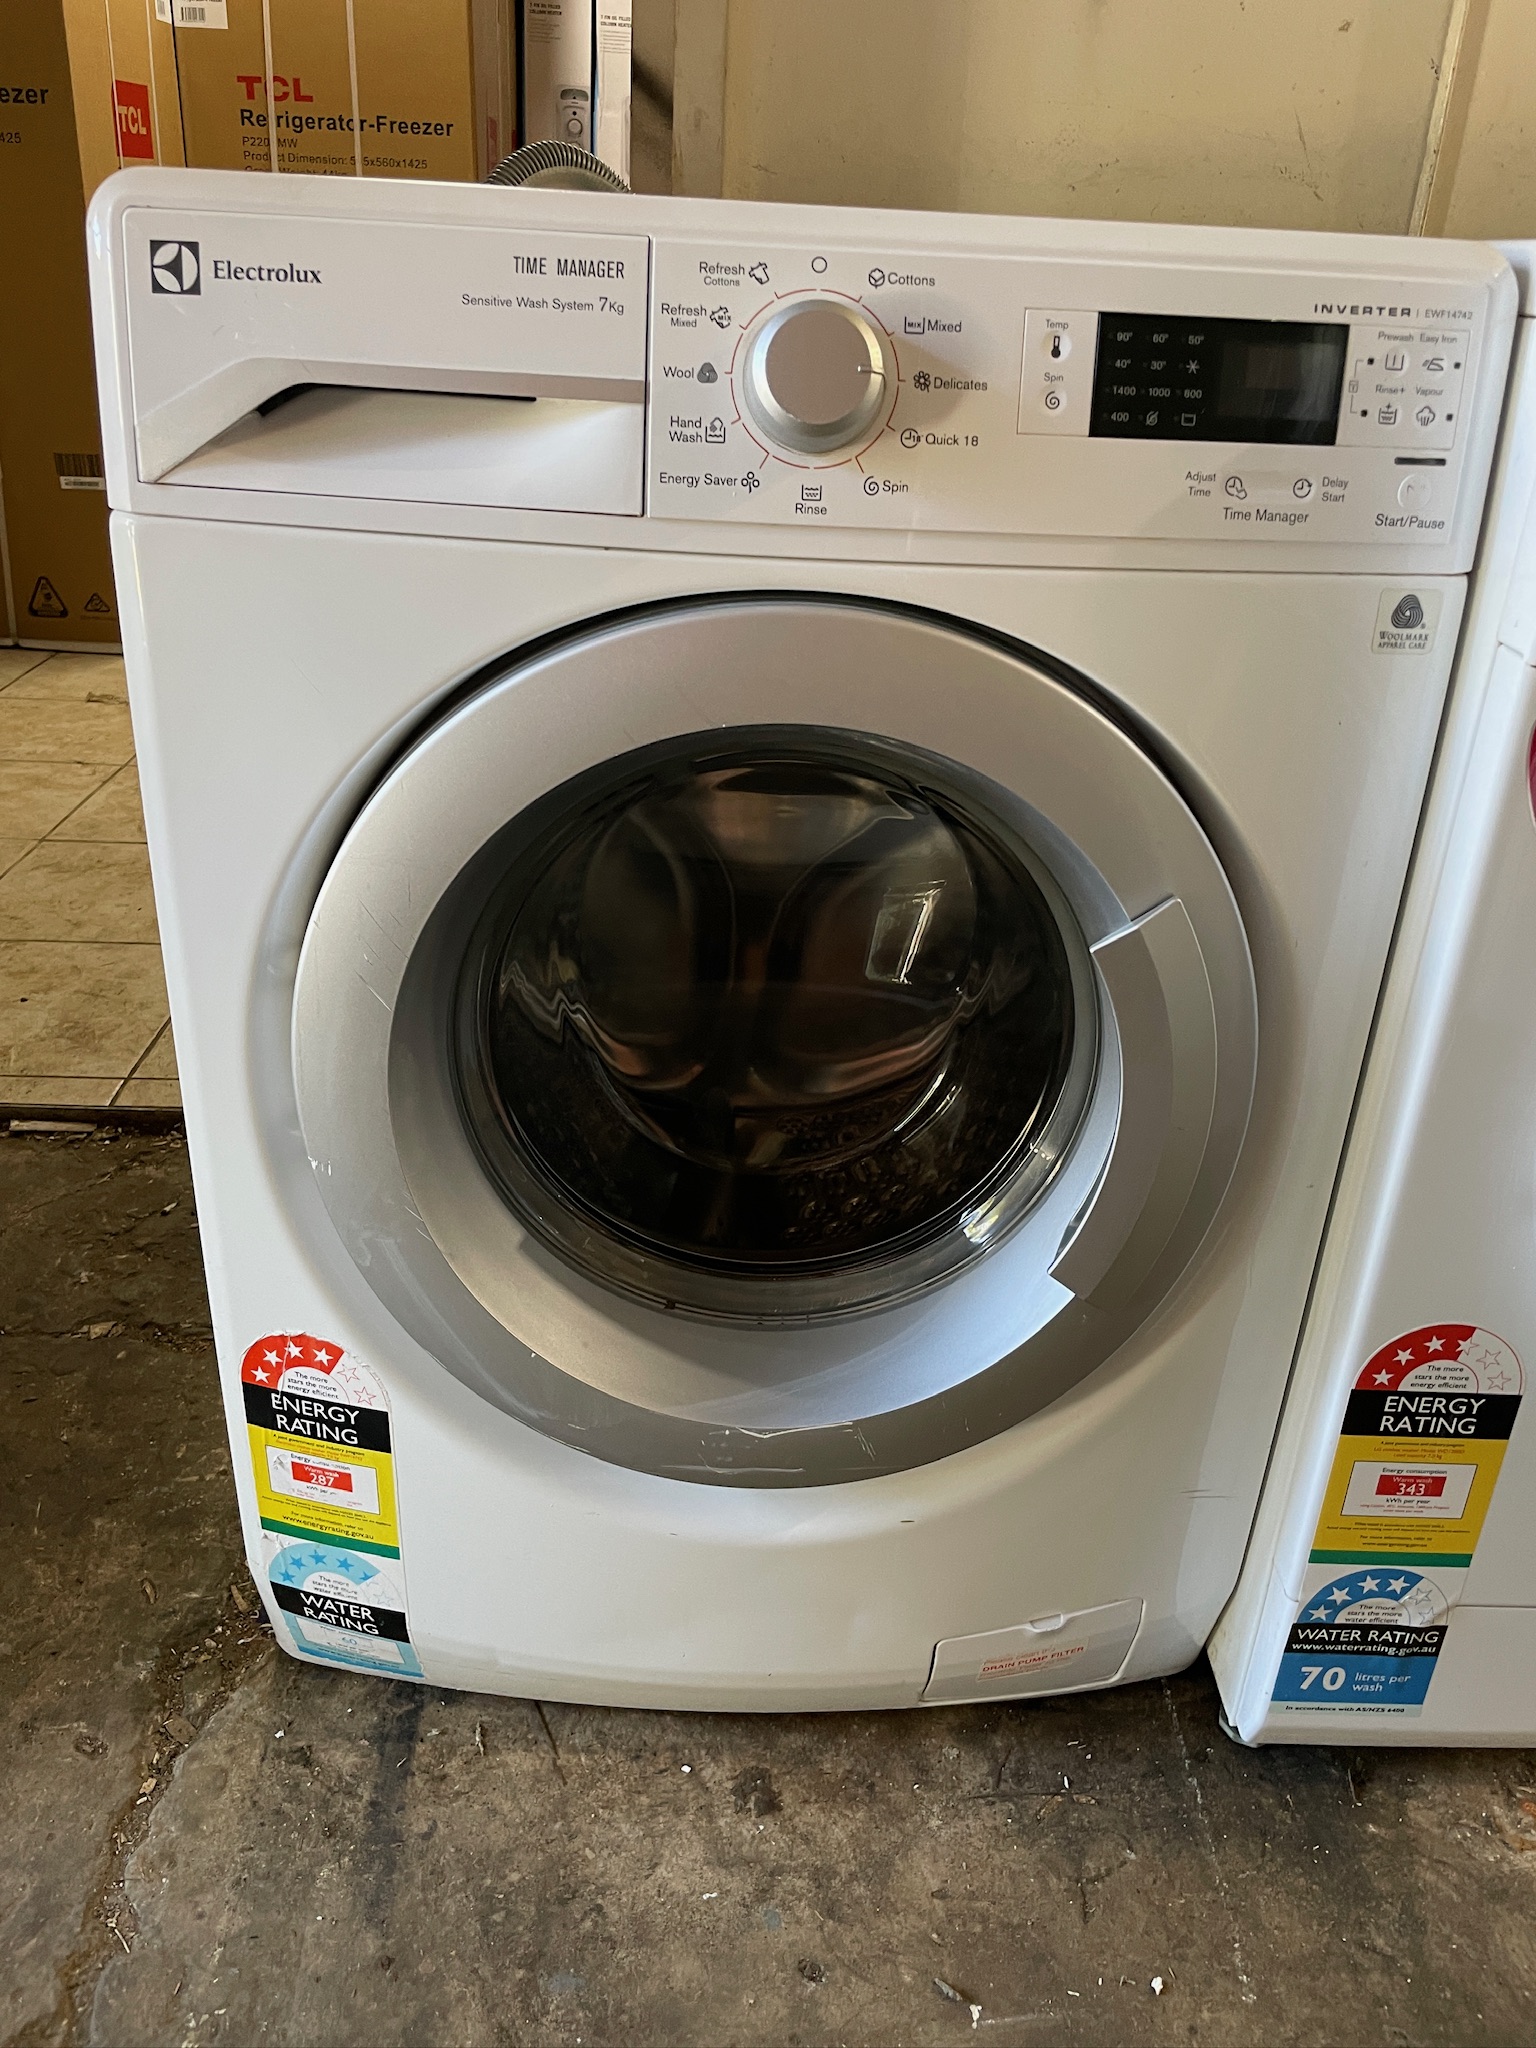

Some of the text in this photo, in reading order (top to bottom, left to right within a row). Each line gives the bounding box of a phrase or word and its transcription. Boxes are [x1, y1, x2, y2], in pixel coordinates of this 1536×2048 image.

[237, 75, 314, 102] TCL
[118, 105, 147, 135] TCL
[242, 136, 298, 148] P220MW
[288, 153, 347, 165] Dimension:
[350, 155, 428, 169] 55x560x1425
[212, 259, 323, 284] Electrolux
[513, 256, 625, 279] TIME MANAGER
[699, 261, 745, 275] Refresh
[703, 275, 740, 287] Cottons
[887, 272, 936, 287] Cottons
[461, 293, 625, 316] Sensitive Wash System 7Kg
[661, 302, 707, 316] Refresh
[1314, 303, 1411, 317] INVERTER
[670, 317, 697, 328] Mixed
[927, 319, 962, 333] Mixed
[1045, 319, 1069, 331] Temp
[1378, 330, 1458, 345] Prewash Easy Iron
[663, 365, 695, 379] Wool
[1043, 372, 1064, 383] Spin
[933, 377, 988, 391] Delicates
[1112, 385, 1136, 396] 1400
[1148, 387, 1171, 397] 1000
[1415, 385, 1443, 397] Vapour
[670, 415, 702, 429] Hand
[1110, 411, 1130, 422] 400
[668, 430, 703, 443] Wash
[925, 433, 979, 447] Quick 18
[659, 472, 738, 488] Energy Saver
[1185, 471, 1216, 484] Adjust
[1321, 476, 1349, 490] Delay
[882, 481, 909, 495] Spin
[1188, 486, 1211, 497] Time
[1321, 492, 1345, 503] Start
[795, 503, 827, 516] Rinse
[1223, 507, 1309, 526] Time Manager
[1374, 513, 1445, 530] Start/Pause
[294, 1371, 328, 1384] The more
[287, 1384, 339, 1399] energy efficient
[270, 1392, 360, 1425] ENERGY
[1383, 1396, 1486, 1415] ENERGY
[275, 1413, 358, 1445] RATING
[1379, 1415, 1477, 1435] RATING
[290, 1453, 312, 1464] Energy
[304, 1465, 323, 1475] Warm
[309, 1473, 335, 1487] 287
[1396, 1483, 1425, 1496] 343
[300, 1592, 375, 1622] WATER
[303, 1606, 379, 1635] RATING
[1297, 1628, 1440, 1645] WATER RATING
[1292, 1643, 1436, 1656] www.waterrating.gov.au
[982, 1662, 1015, 1672] DRAIN
[1017, 1655, 1048, 1666] PUMP
[1050, 1646, 1084, 1660] FILTER
[1300, 1665, 1411, 1691] 70 litres per
[1352, 1683, 1383, 1692] wash
